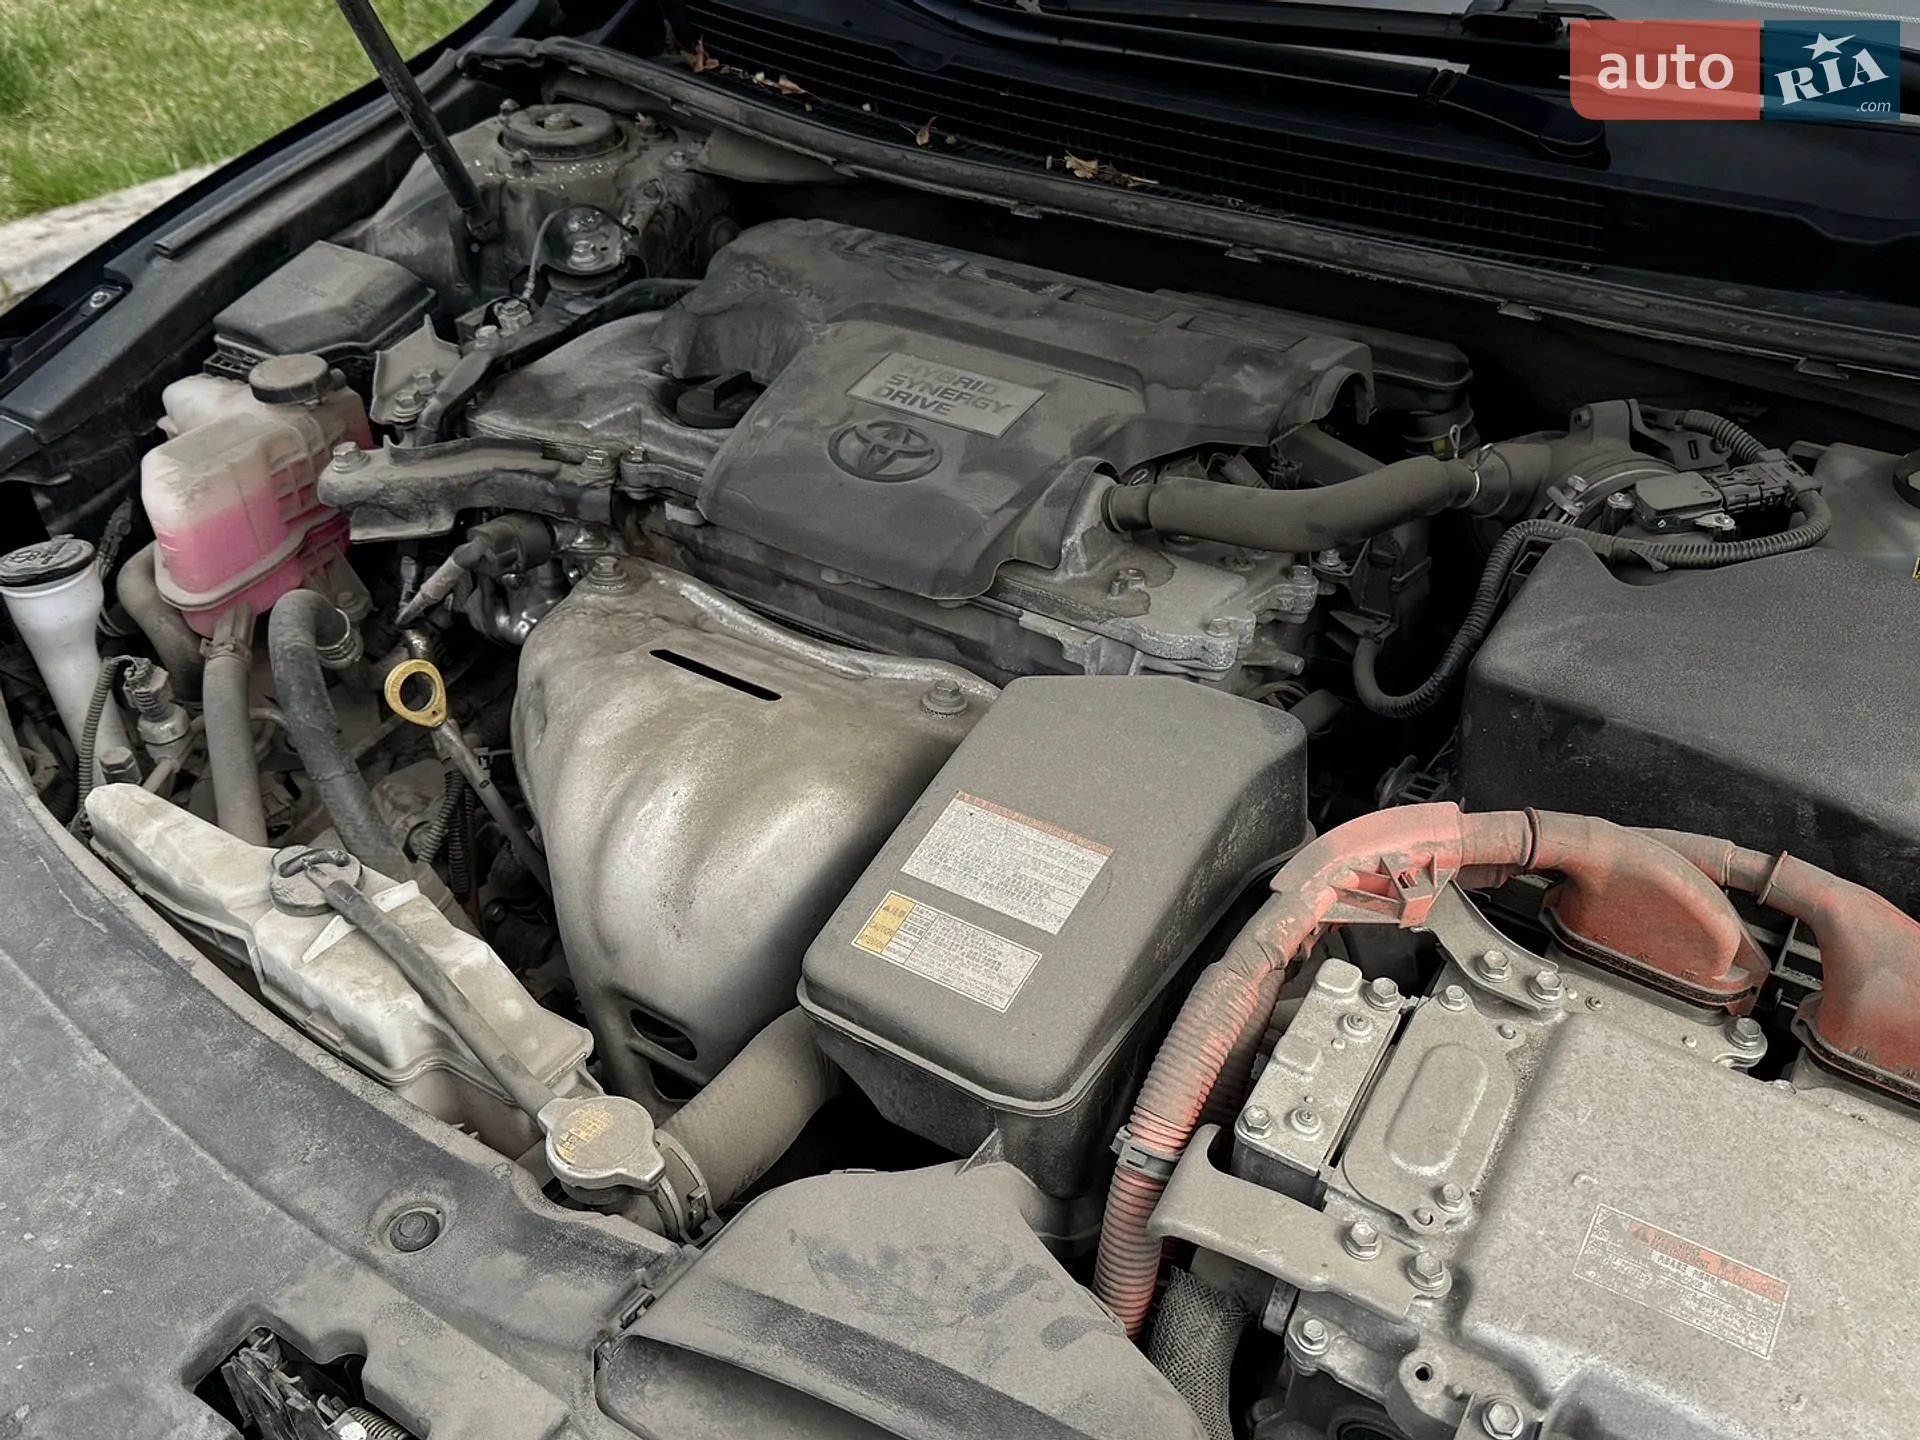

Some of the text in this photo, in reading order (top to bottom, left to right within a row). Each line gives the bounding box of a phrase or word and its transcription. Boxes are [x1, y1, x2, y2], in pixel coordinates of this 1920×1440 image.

[887, 373, 1014, 415] SYNERGY
[902, 361, 997, 395] HYBRID
[872, 387, 957, 416] DRIVE
